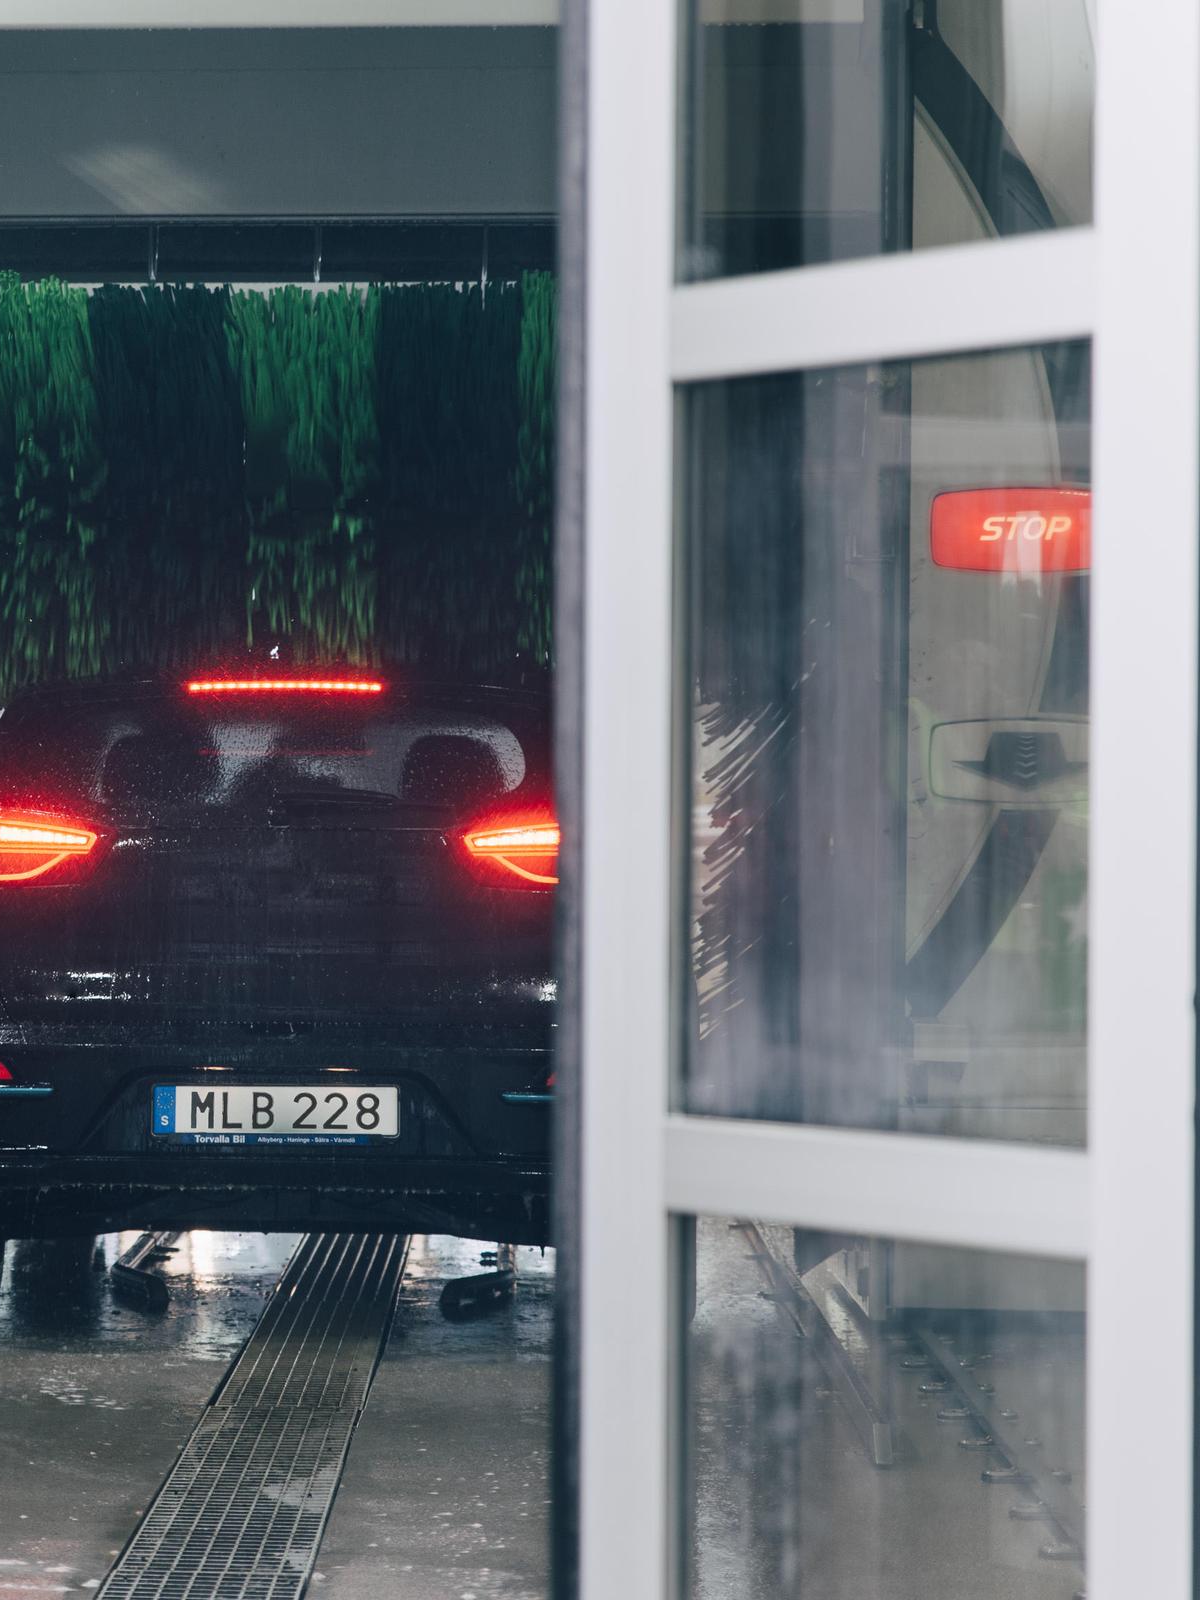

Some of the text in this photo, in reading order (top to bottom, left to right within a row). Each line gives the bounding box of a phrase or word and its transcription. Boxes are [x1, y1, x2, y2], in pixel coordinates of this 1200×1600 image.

[979, 516, 1072, 541] STOP
[190, 1091, 380, 1130] MLB 228
[160, 1114, 169, 1127] S
[194, 1134, 246, 1144] Torvalla Bil
[257, 1136, 282, 1144] Albyberg
[287, 1136, 310, 1144] Haninge
